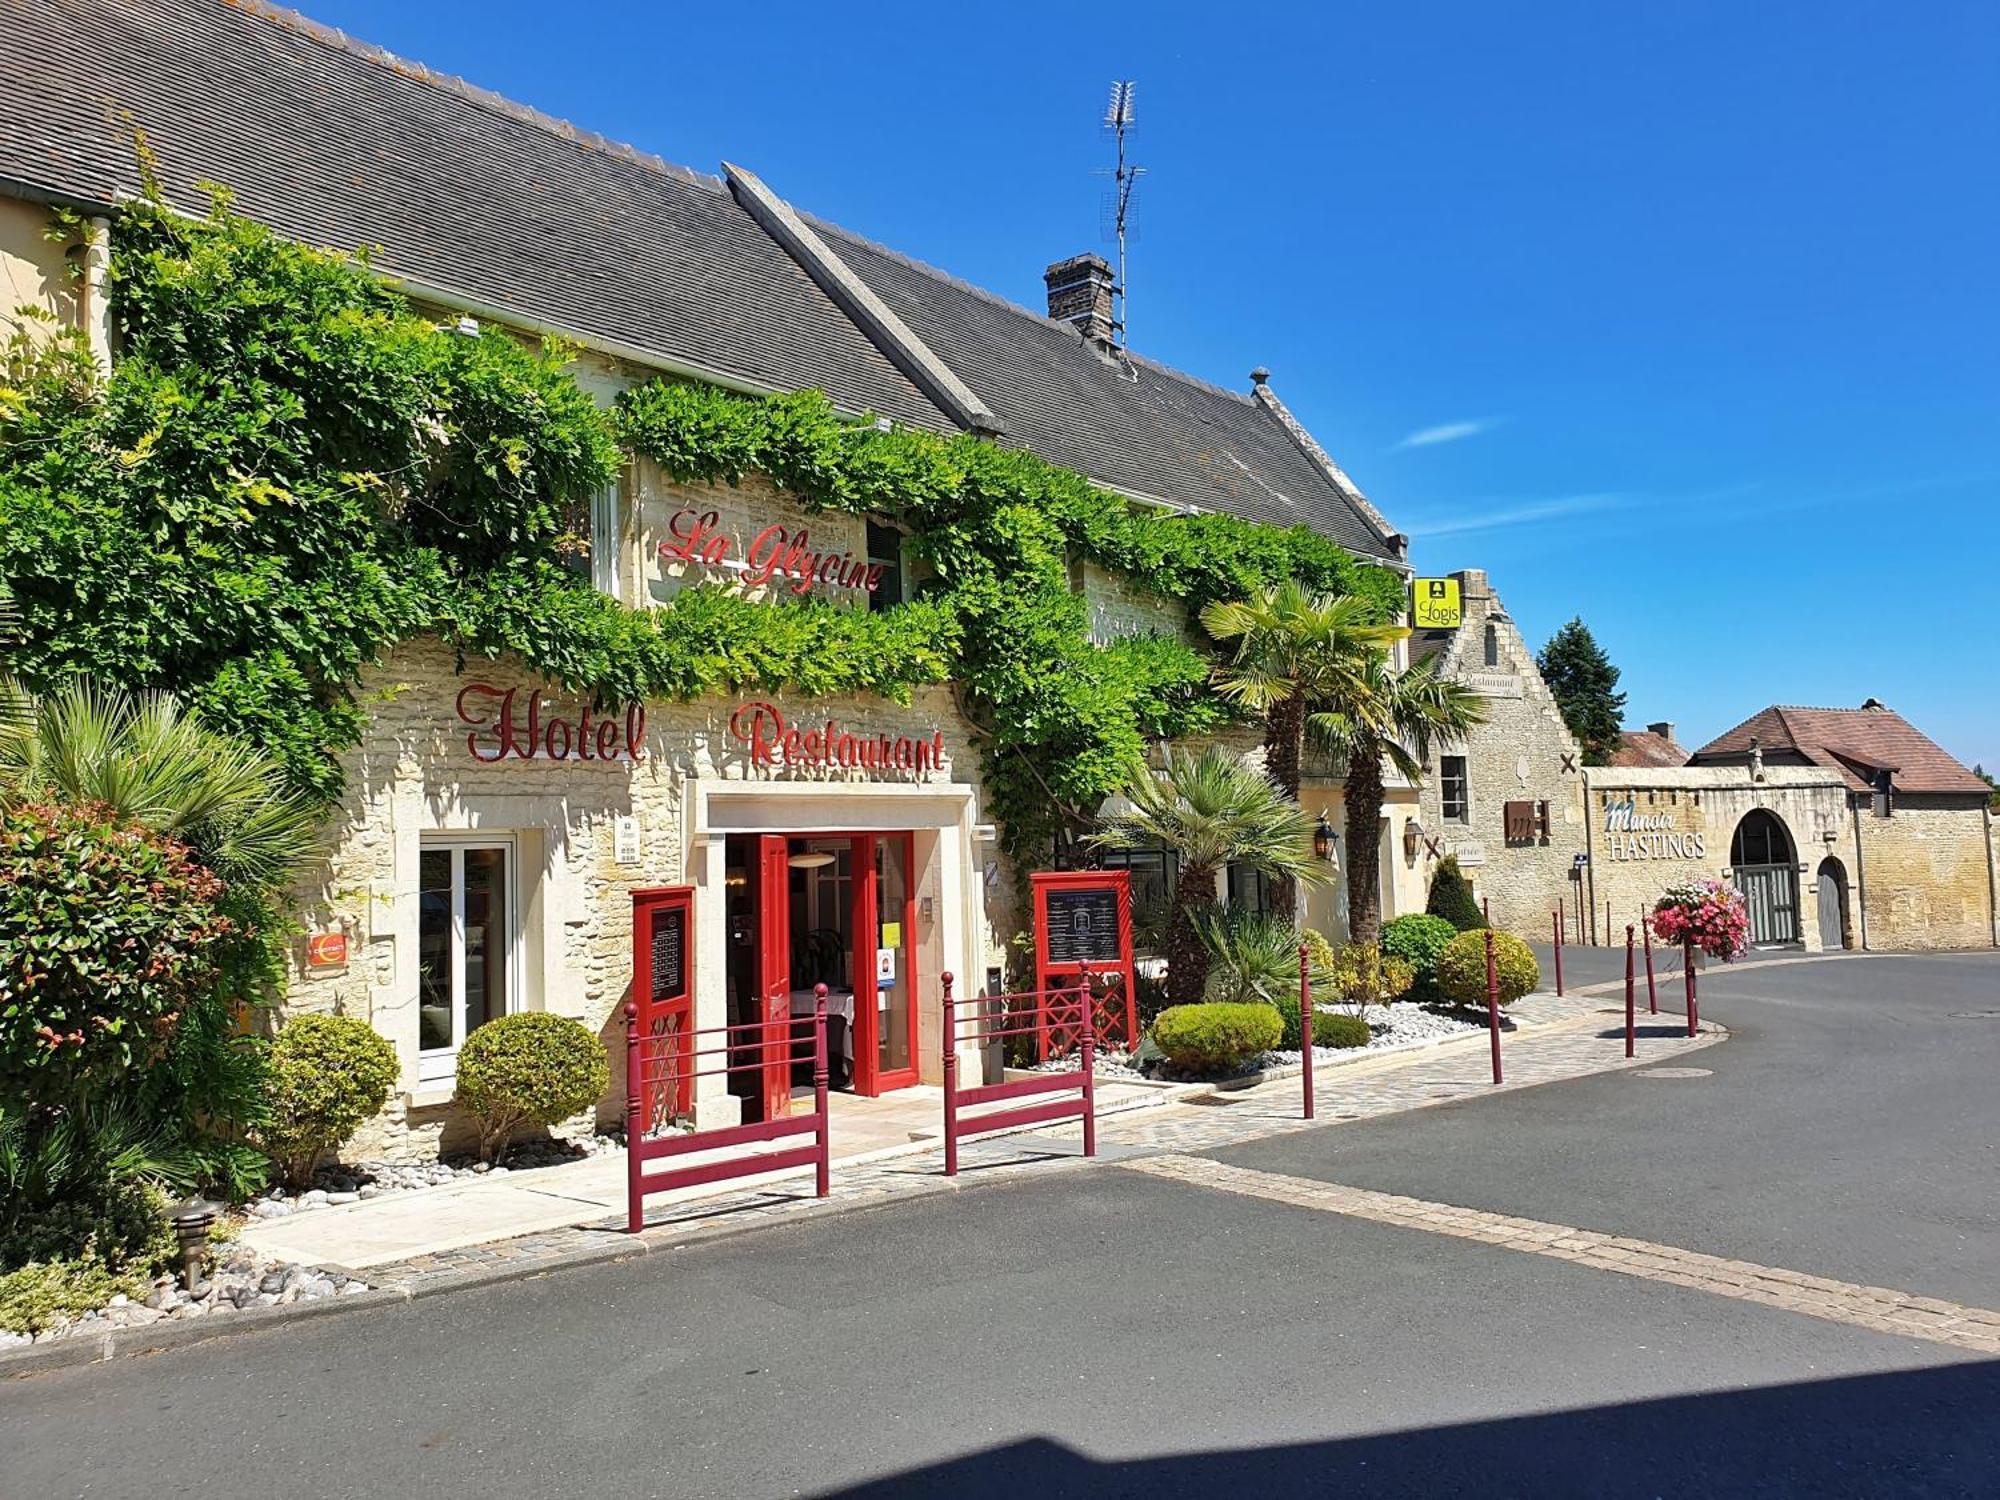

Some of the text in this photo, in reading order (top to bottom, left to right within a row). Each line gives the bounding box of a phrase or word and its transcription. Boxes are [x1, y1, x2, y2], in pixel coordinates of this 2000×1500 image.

[659, 509, 884, 594] La Glycine
[1418, 600, 1459, 626] Logis
[731, 702, 945, 772] Restaurant
[1604, 799, 1675, 832] Manoir
[1605, 833, 1706, 861] HASTINGS
